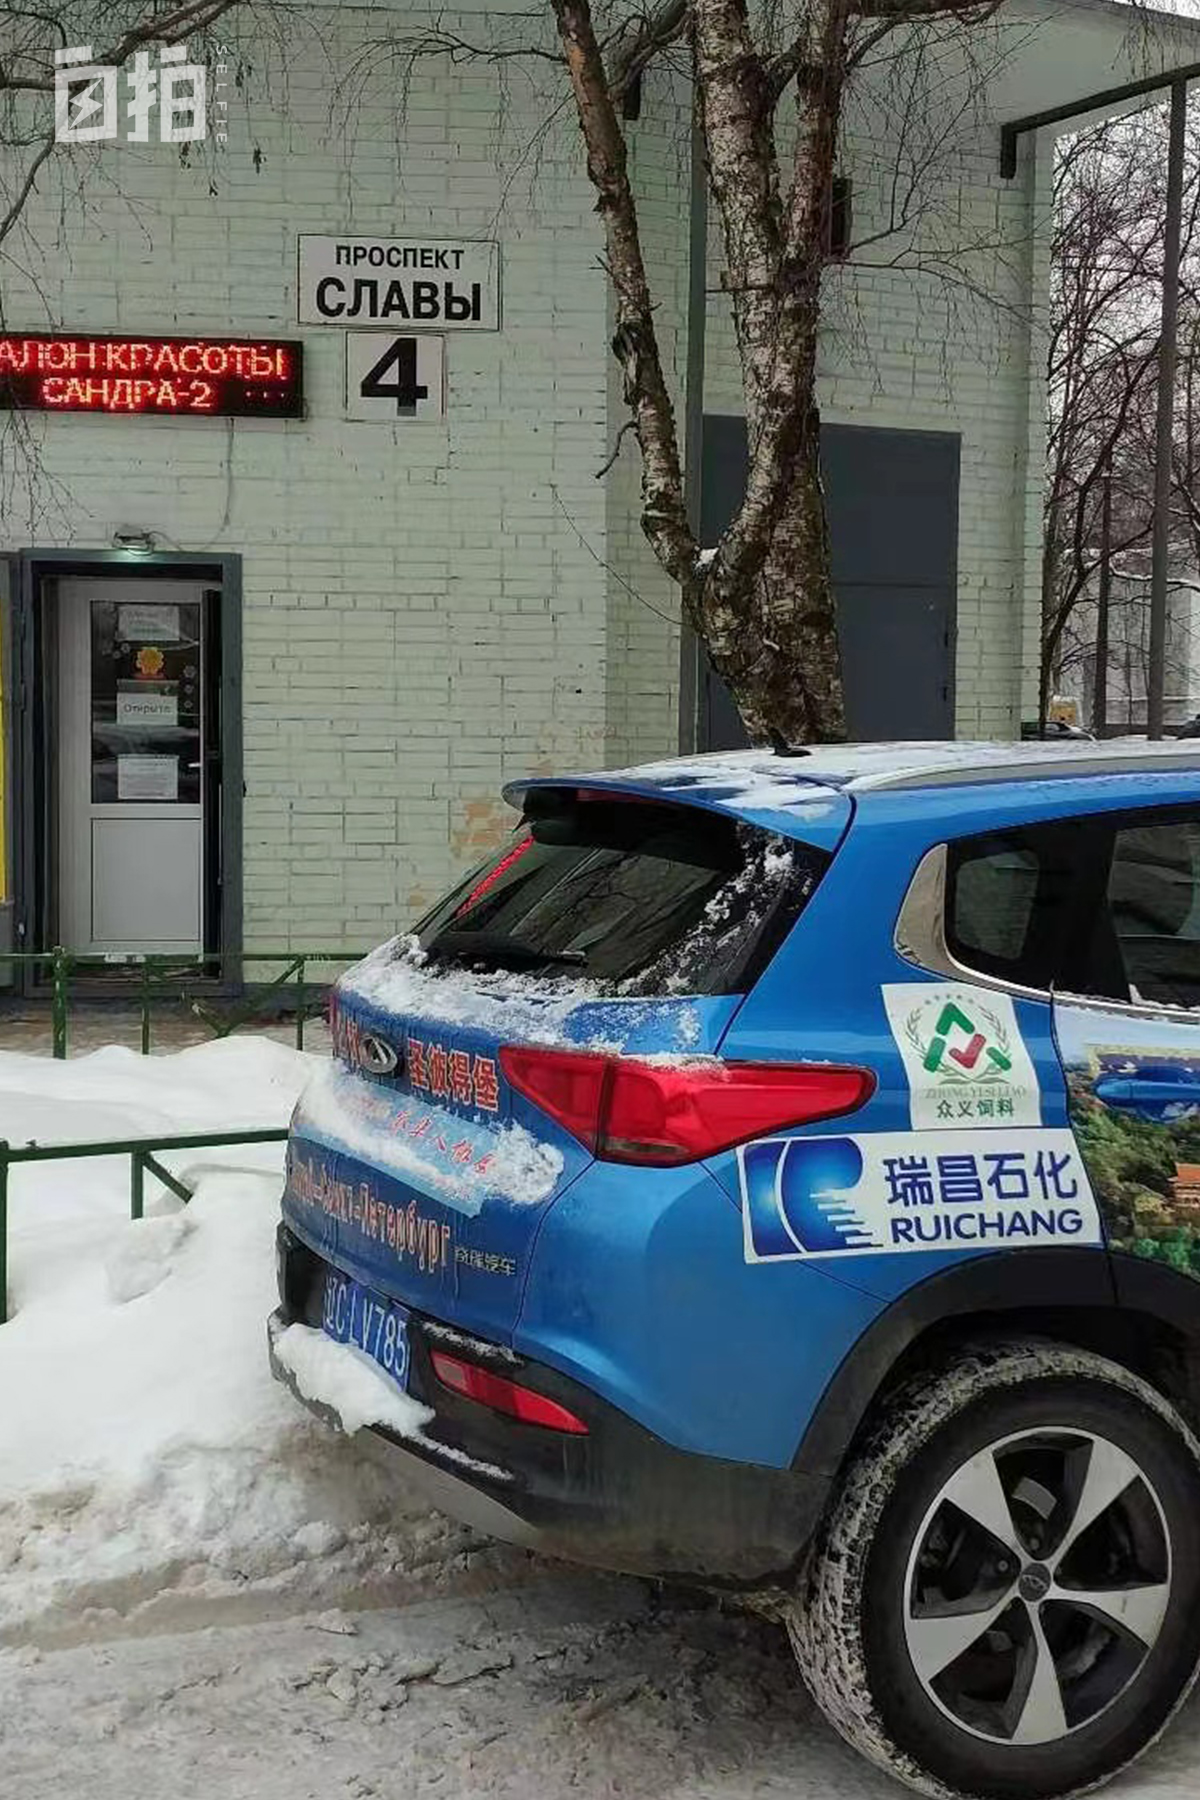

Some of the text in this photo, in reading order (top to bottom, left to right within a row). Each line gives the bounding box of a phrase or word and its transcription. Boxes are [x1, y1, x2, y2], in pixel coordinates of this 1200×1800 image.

[335, 244, 465, 270] ПРОСПЕКТ
[315, 276, 482, 321] СЛАВЫ
[105, 343, 284, 377] КРАСОТЫ
[360, 337, 429, 417] 4
[42, 377, 212, 409] САНДРА-2
[937, 1099, 1015, 1119] 众义饲料
[882, 1150, 1078, 1207] 瑞昌石化
[891, 1209, 1083, 1243] RUICHANG
